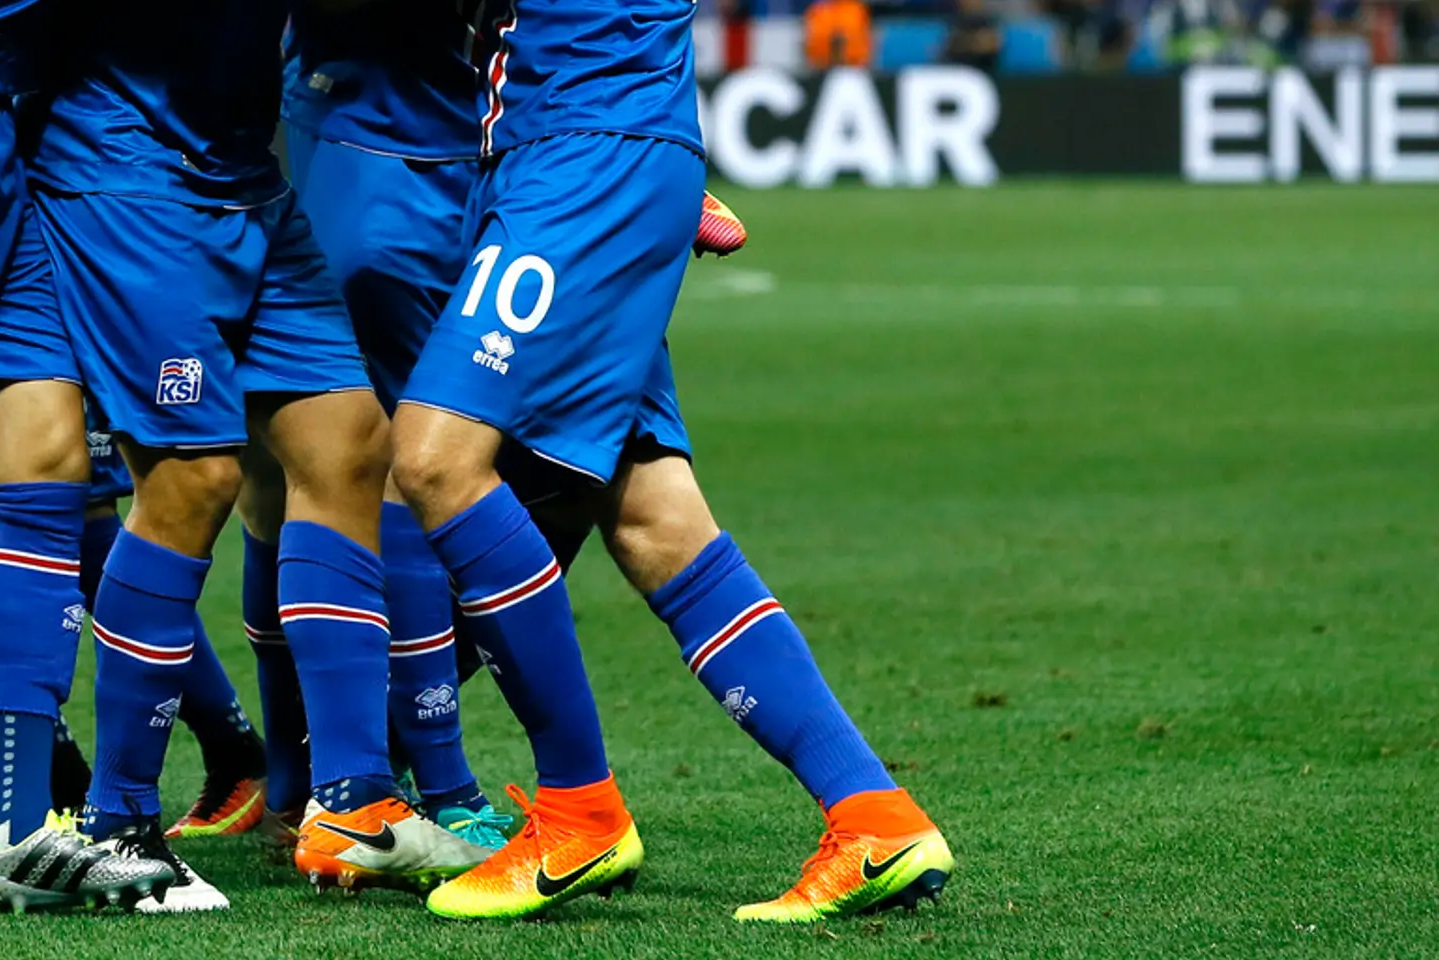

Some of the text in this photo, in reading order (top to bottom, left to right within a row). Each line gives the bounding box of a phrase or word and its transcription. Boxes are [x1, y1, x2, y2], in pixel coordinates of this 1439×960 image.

[699, 64, 1439, 188] CAR ENE
[461, 244, 556, 334] 10
[159, 380, 199, 402] KSI
[472, 350, 510, 375] errea
